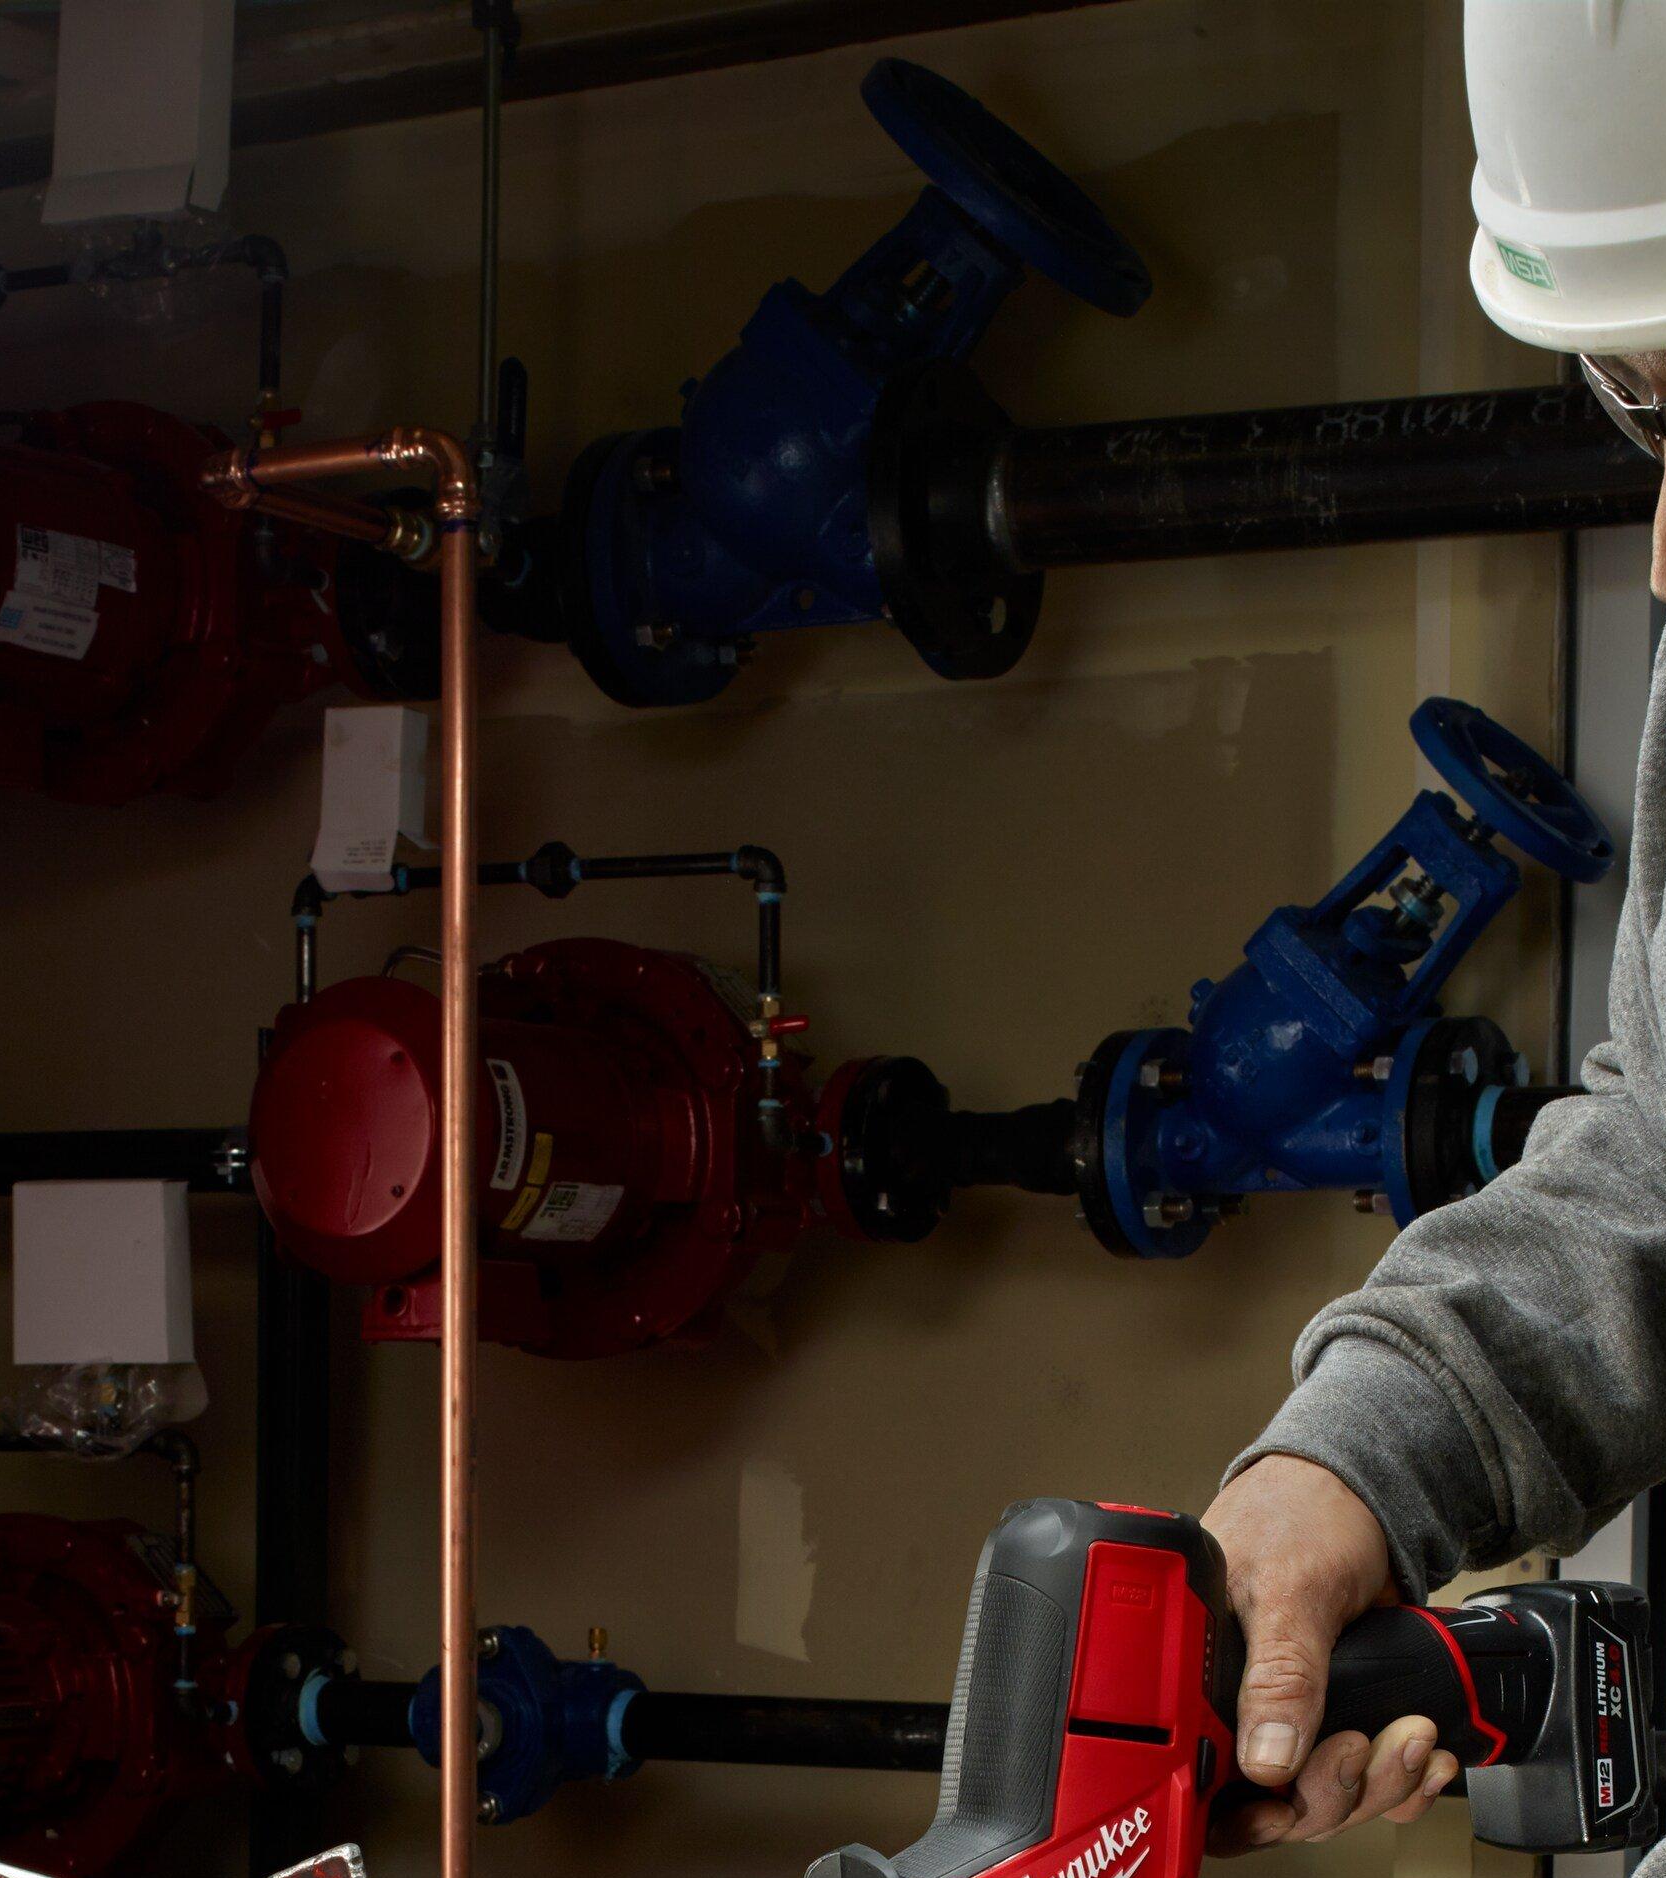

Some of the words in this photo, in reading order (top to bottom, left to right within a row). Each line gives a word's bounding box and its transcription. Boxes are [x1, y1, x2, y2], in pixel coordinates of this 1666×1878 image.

[1498, 244, 1552, 287] MSA
[496, 1084, 515, 1180] ARMSTRONG
[1599, 1761, 1614, 1805] M12
